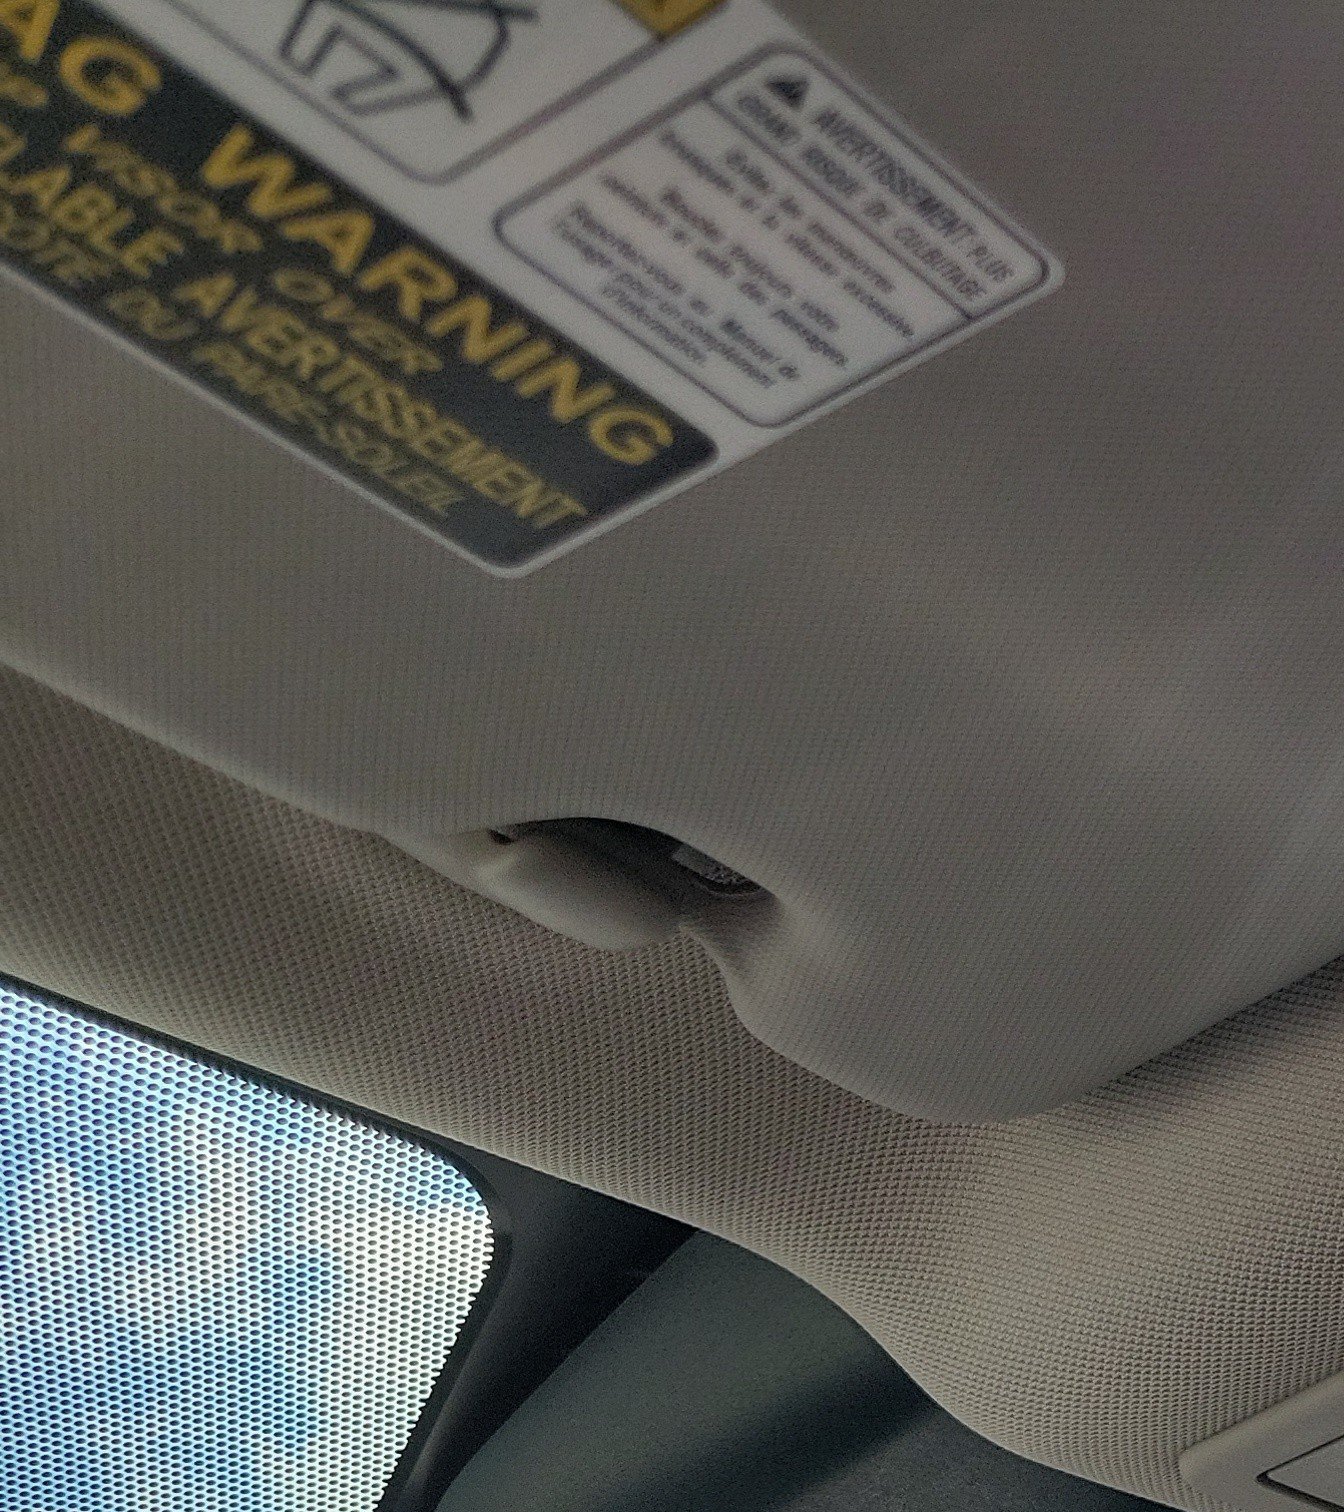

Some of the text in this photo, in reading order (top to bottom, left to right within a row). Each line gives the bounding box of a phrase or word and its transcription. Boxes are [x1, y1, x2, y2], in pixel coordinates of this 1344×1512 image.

[202, 124, 676, 466] WARNING
[814, 108, 1014, 284] AVERTISSEMENT PLUS
[893, 223, 987, 301] CULBUTAGE
[171, 272, 587, 530] AVERTISSEMENT
